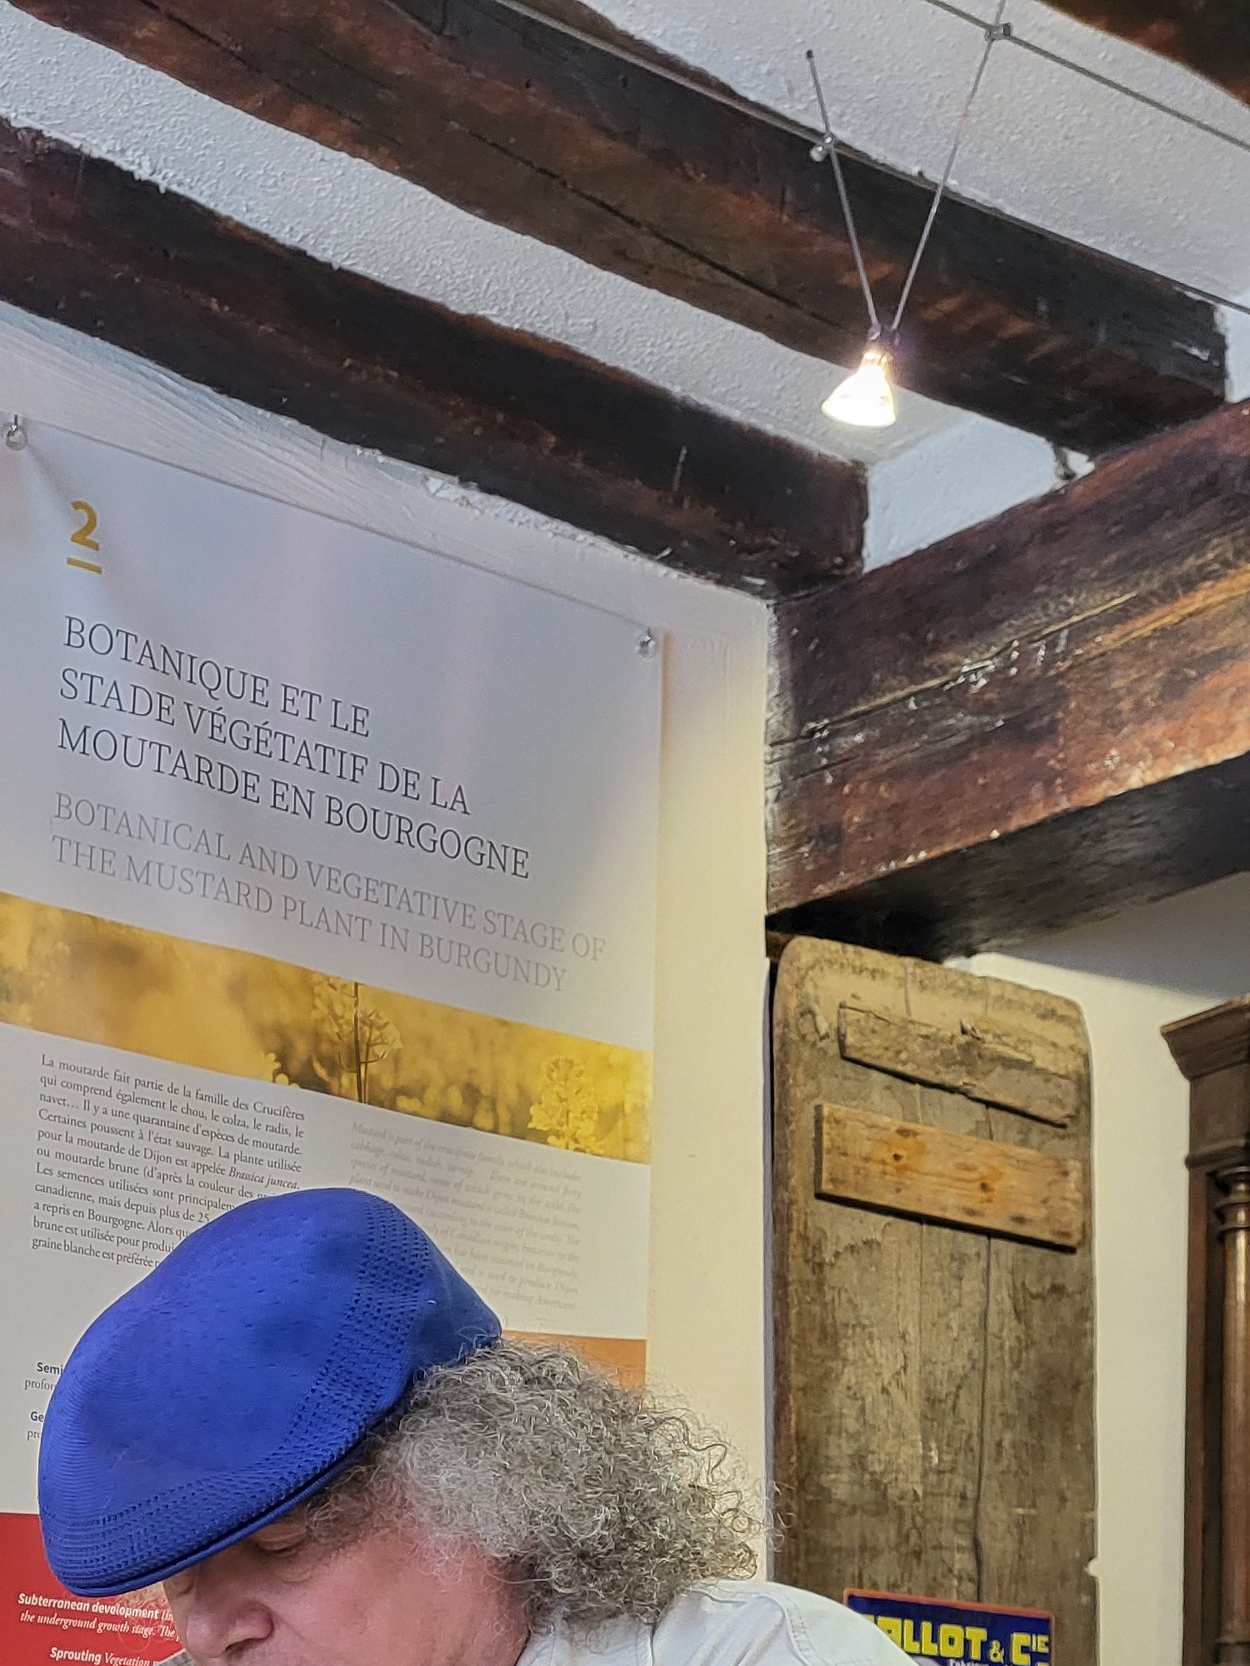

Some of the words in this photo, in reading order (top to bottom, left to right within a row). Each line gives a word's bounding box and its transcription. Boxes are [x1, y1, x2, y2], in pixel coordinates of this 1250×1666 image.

[69, 500, 99, 551] 2
[63, 615, 270, 708] BOTANIQUE
[281, 683, 321, 721] ET
[330, 699, 370, 737] LE
[60, 668, 176, 726] STADE
[183, 702, 368, 783] VÉGÉTATIF
[378, 761, 420, 801] DE
[430, 776, 470, 815] LA
[58, 718, 260, 804] MOUTARDE
[270, 779, 315, 819] EN
[325, 795, 529, 879] BOURGOGNE
[53, 791, 231, 861] BOTANICAL
[238, 843, 298, 880] AND
[305, 861, 476, 930] VEGETATIVE
[483, 909, 565, 953] STAGE
[572, 932, 606, 961] OF
[52, 835, 116, 877] THE
[126, 855, 273, 913] MUSTARD
[282, 895, 372, 942] PLANT
[380, 922, 409, 953] IN
[419, 932, 567, 992] BURGUNDY
[40, 1076, 57, 1088] qui
[60, 1080, 113, 1098] comprend
[115, 1090, 166, 1110] également
[169, 1099, 178, 1112] le
[180, 1103, 208, 1120] chou,
[210, 1109, 220, 1122] le
[222, 1114, 250, 1128] colza,
[252, 1118, 262, 1130] le
[265, 1122, 292, 1137] radis,
[295, 1125, 304, 1138] le
[41, 1054, 54, 1068] La
[58, 1062, 110, 1080] moutarde
[113, 1069, 130, 1084] fait
[134, 1078, 164, 1092] partie
[166, 1082, 180, 1096] de
[182, 1085, 192, 1098] la
[195, 1088, 230, 1106] famille
[232, 1096, 249, 1110] des
[252, 1102, 305, 1120] Crucifères
[38, 1108, 87, 1128] Certaines
[90, 1122, 134, 1138] poussent
[137, 1129, 144, 1140] à
[148, 1130, 172, 1146] l'état
[175, 1140, 214, 1158] sauvage.
[218, 1146, 230, 1160] La
[233, 1150, 264, 1166] plante
[267, 1158, 302, 1172] utilisée
[82, 1098, 91, 1112] Il
[92, 1105, 100, 1116] y
[110, 1109, 130, 1120] une
[132, 1114, 190, 1132] quarantaine
[192, 1123, 235, 1143] d'espèces
[237, 1133, 250, 1146] de
[252, 1140, 302, 1156] moutarde.
[36, 1148, 50, 1158] ou
[54, 1152, 106, 1168] moutarde
[108, 1158, 140, 1176] brune
[143, 1166, 182, 1184] (d'après
[186, 1173, 195, 1186] la
[198, 1180, 235, 1194] couleur
[238, 1185, 254, 1198] des
[36, 1162, 54, 1176] Les
[57, 1170, 105, 1186] semences
[108, 1178, 149, 1194] utilisées
[152, 1188, 174, 1200] sont
[37, 1130, 62, 1142] pour
[65, 1130, 74, 1144] la
[76, 1138, 126, 1154] moutarde
[128, 1144, 140, 1158] de
[143, 1148, 172, 1164] Dijon
[175, 1158, 188, 1168] est
[190, 1162, 226, 1176] appelée
[228, 1166, 265, 1184] Brassica
[264, 1174, 300, 1190] juncea.
[33, 1202, 40, 1210] a
[42, 1204, 70, 1216] repris
[72, 1210, 85, 1218] en
[88, 1208, 145, 1232] Bourgogne.
[147, 1220, 174, 1236] Alors
[34, 1184, 95, 1204] canadienne,
[98, 1196, 122, 1208] mais
[124, 1198, 156, 1215] depuis
[159, 1204, 180, 1220] plus
[182, 1208, 195, 1222] de
[32, 1238, 62, 1250] graine
[63, 1239, 101, 1258] blanche
[101, 1252, 114, 1260] est
[116, 1252, 154, 1271] préférée
[33, 1216, 64, 1232] brune
[64, 1226, 78, 1236] est
[80, 1227, 115, 1242] utilisée
[116, 1236, 140, 1248] pour
[18, 1593, 90, 1612] Subterranean
[91, 1601, 160, 1619] development
[20, 1610, 34, 1623] the
[37, 1612, 96, 1629] underground
[98, 1619, 130, 1633] growth
[131, 1624, 155, 1639] stage.
[158, 1625, 175, 1638] The
[50, 1647, 102, 1665] Sprouting
[863, 1614, 987, 1661] ALLOT
[989, 1640, 1005, 1663] &
